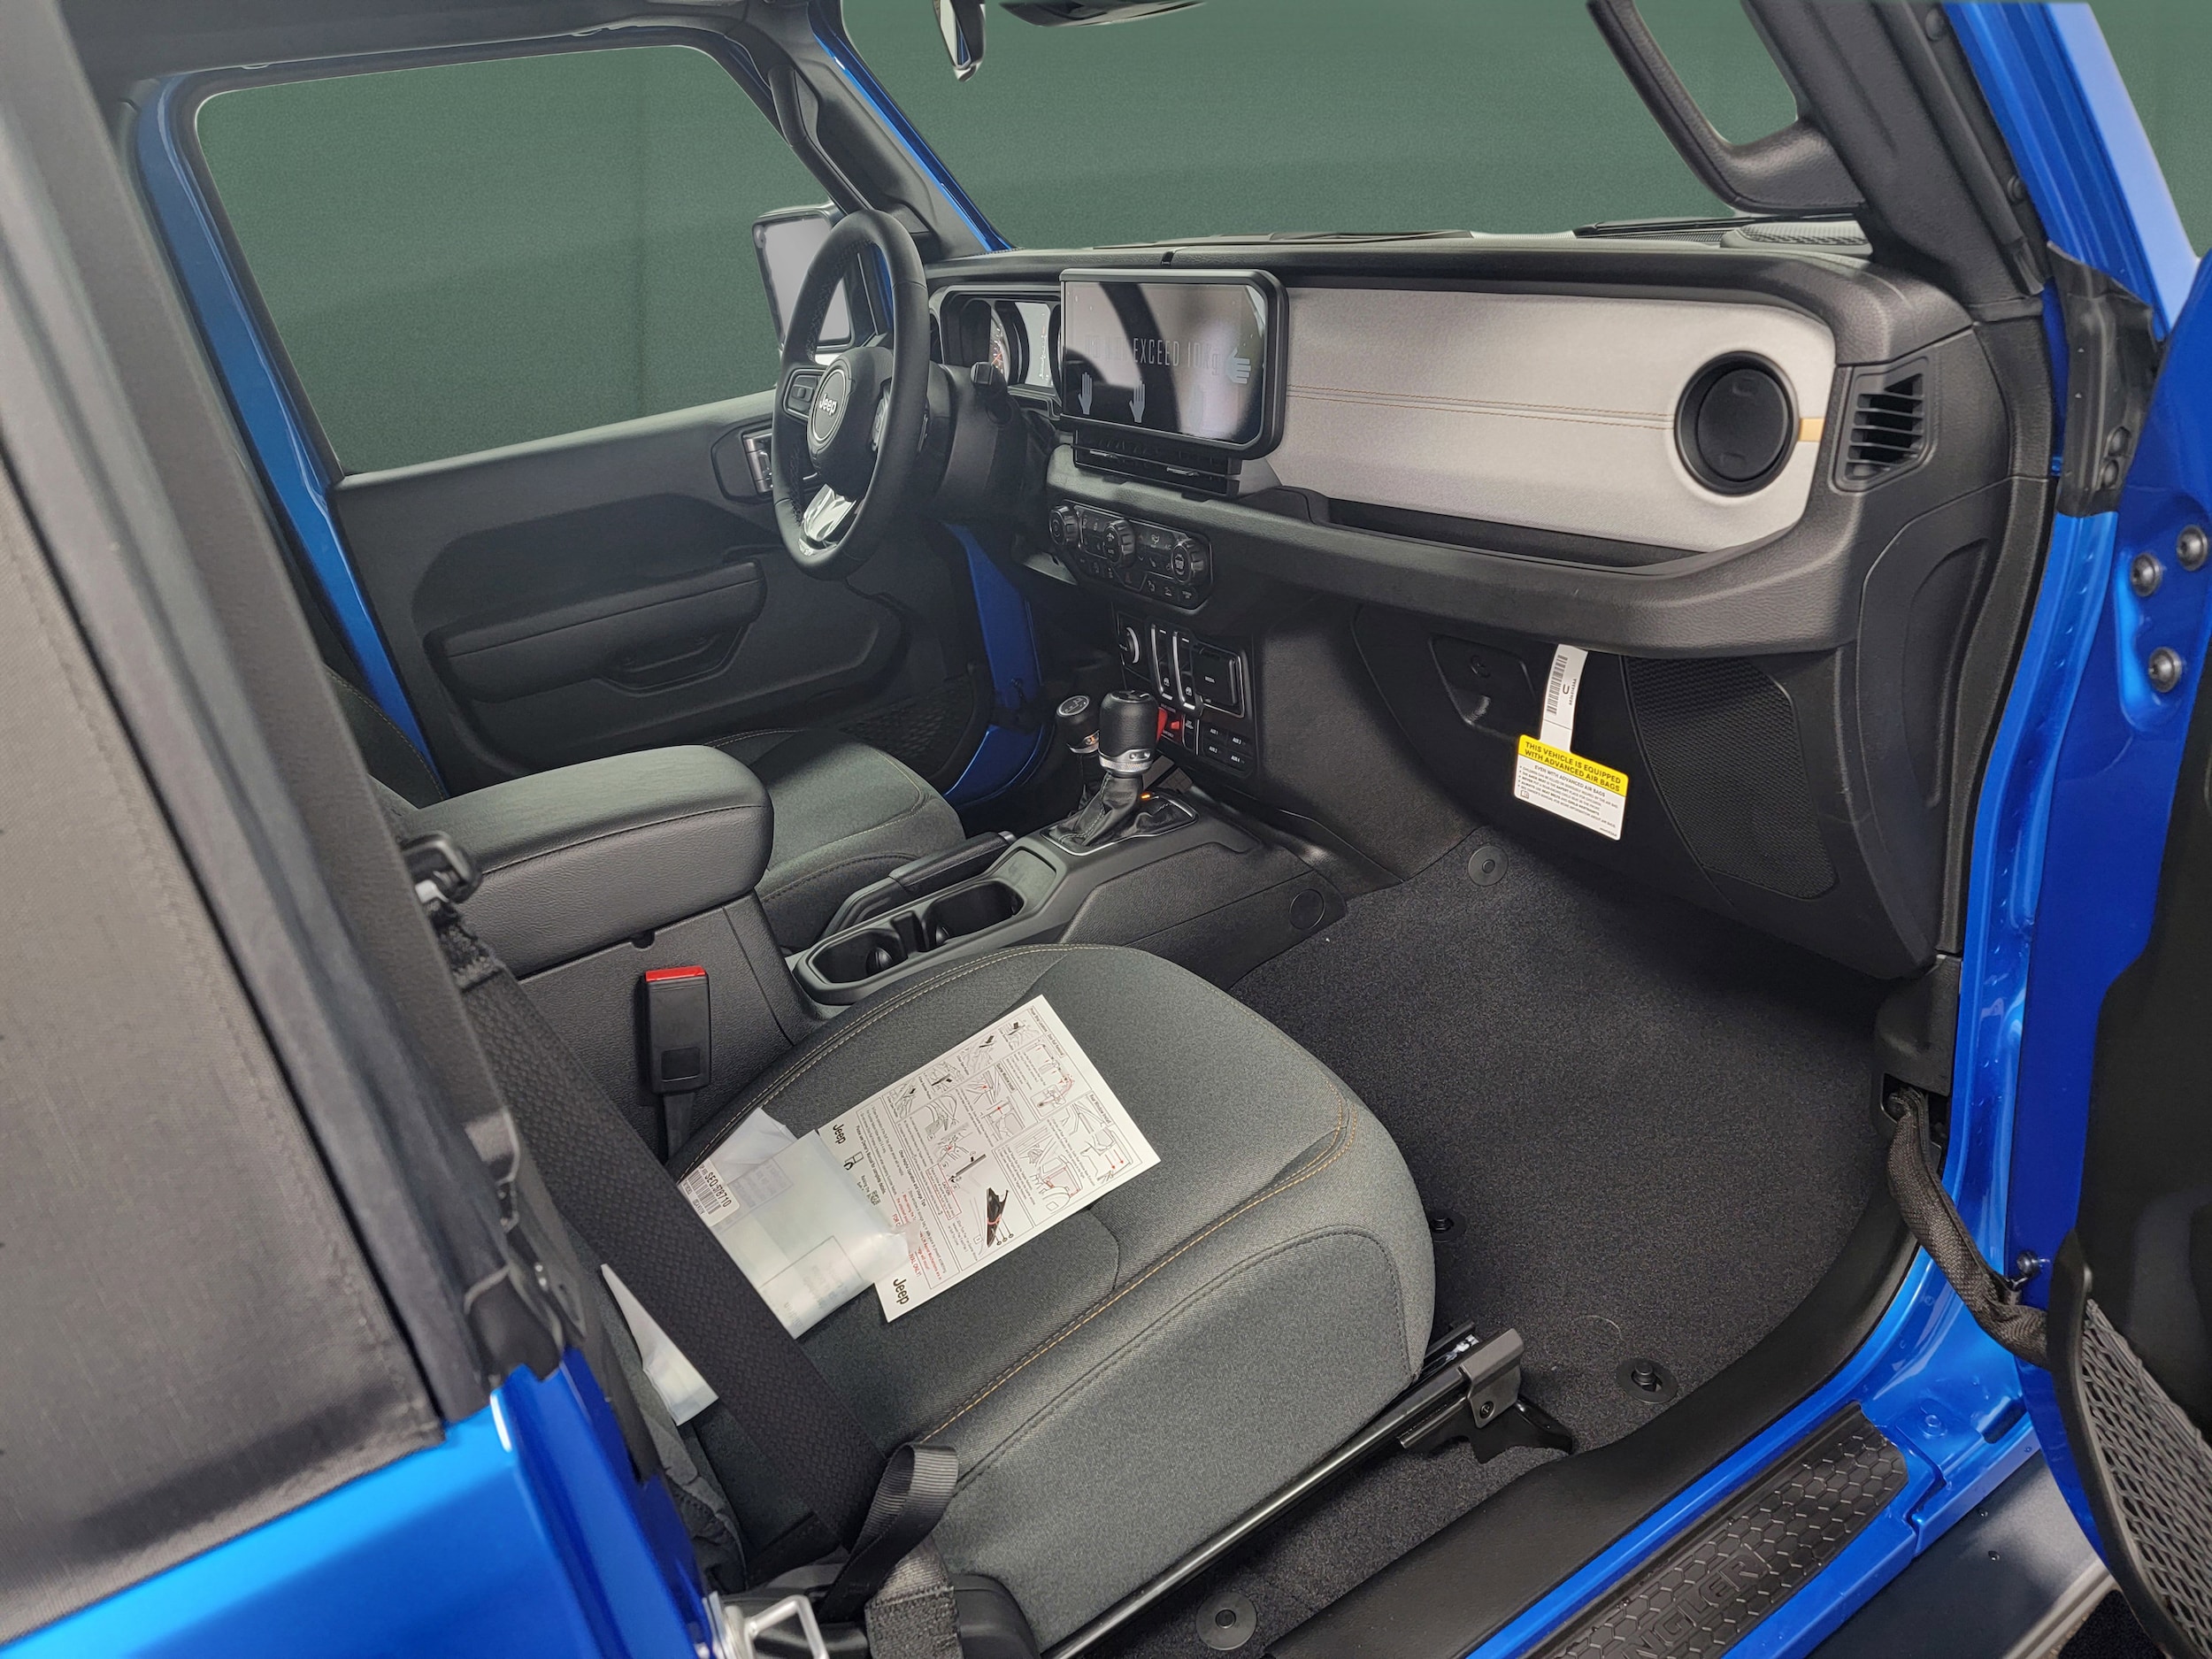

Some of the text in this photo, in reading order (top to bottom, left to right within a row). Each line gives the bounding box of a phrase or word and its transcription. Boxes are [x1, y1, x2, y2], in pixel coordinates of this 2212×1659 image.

[1133, 337, 1179, 367] EXCEED
[819, 393, 837, 416] Jeep
[1525, 741, 1541, 753] THIS
[1543, 748, 1572, 765] VEHICLE
[1585, 764, 1620, 784] EQUIPPED
[1525, 749, 1619, 792] WITH ADVANCED AIR BAGS
[1559, 774, 1583, 787] ADVANCED
[832, 1124, 847, 1145] Jeep
[893, 1278, 910, 1306] Jeep
